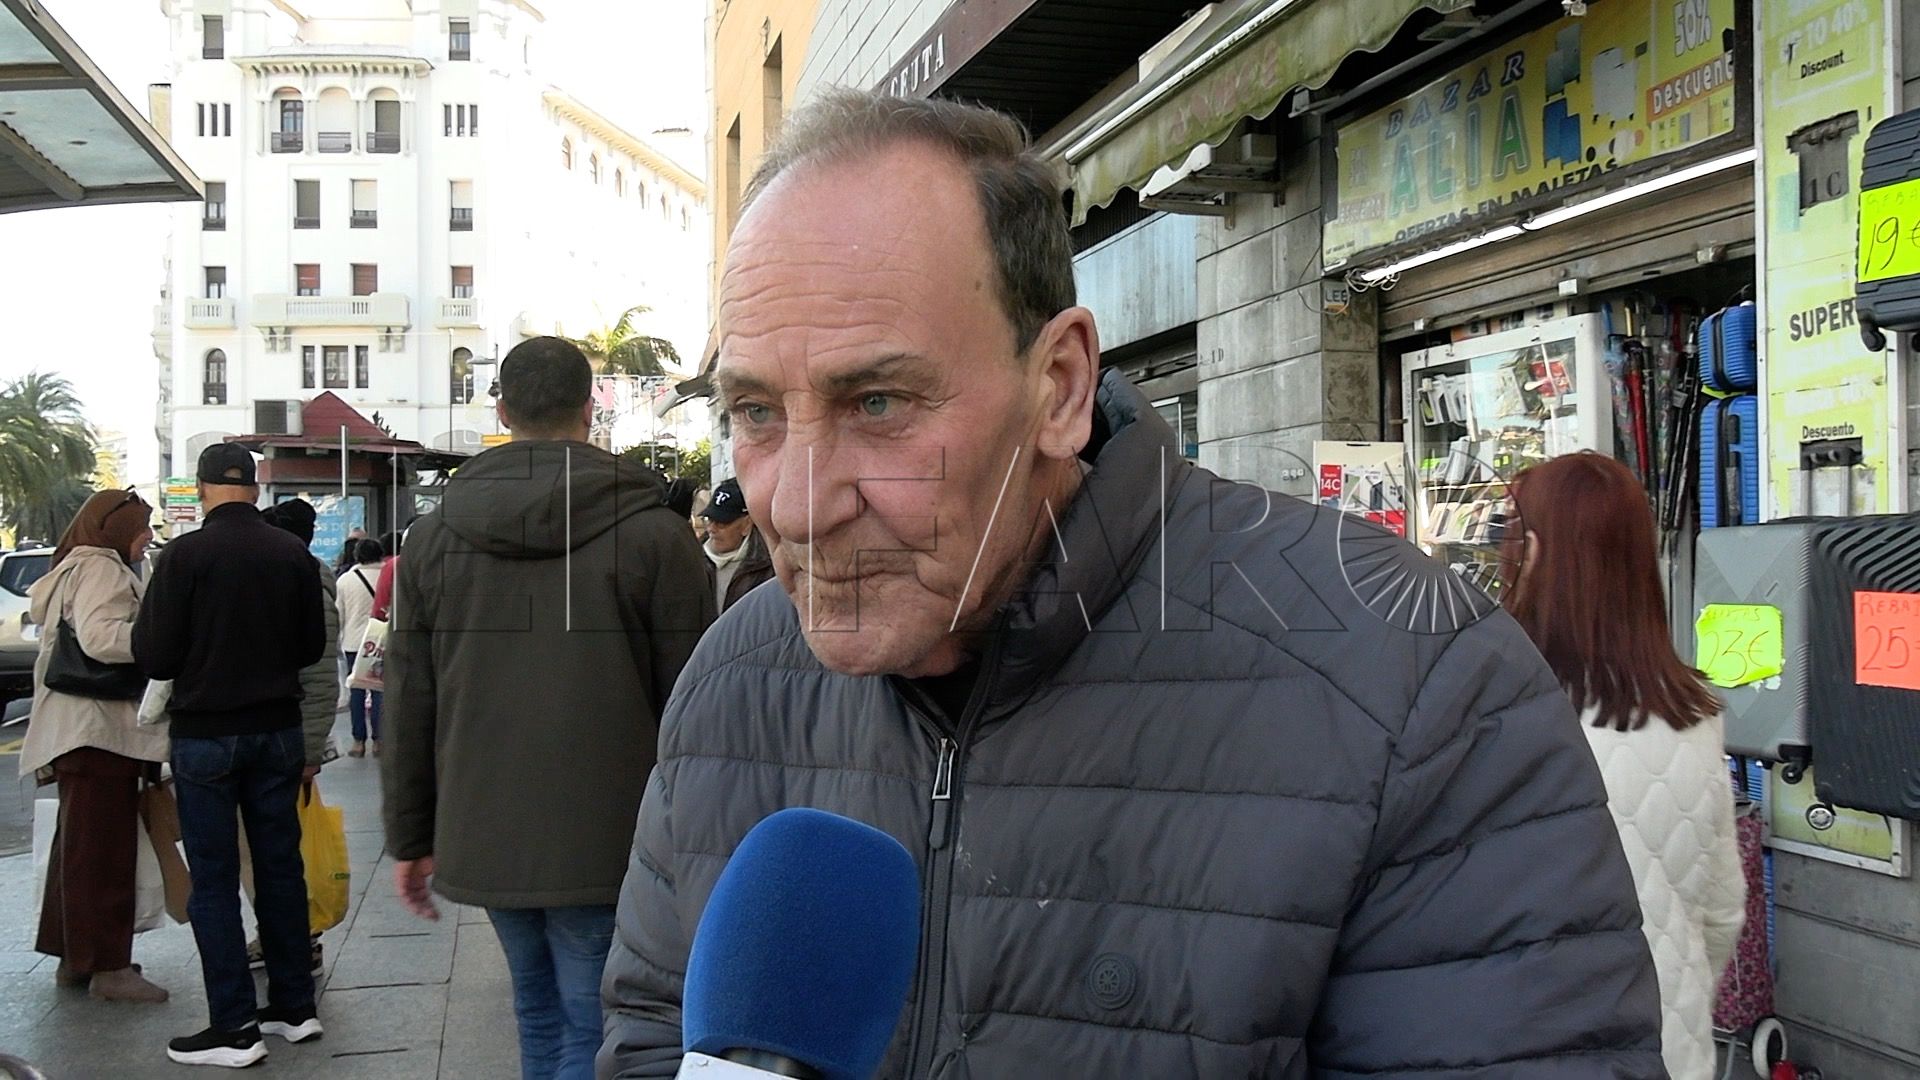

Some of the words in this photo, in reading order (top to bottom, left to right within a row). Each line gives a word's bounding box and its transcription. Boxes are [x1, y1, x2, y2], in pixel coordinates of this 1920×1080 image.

[1673, 0, 1712, 57] 50%
[1800, 49, 1845, 79] Discount
[1386, 50, 1535, 139] BAZAR
[1388, 86, 1531, 220] ALIA
[1477, 195, 1504, 218] EN
[1510, 157, 1619, 204] MALETAS
[1789, 298, 1855, 342] SUPER
[1801, 422, 1855, 439] Descuento
[1320, 478, 1341, 491] 14C
